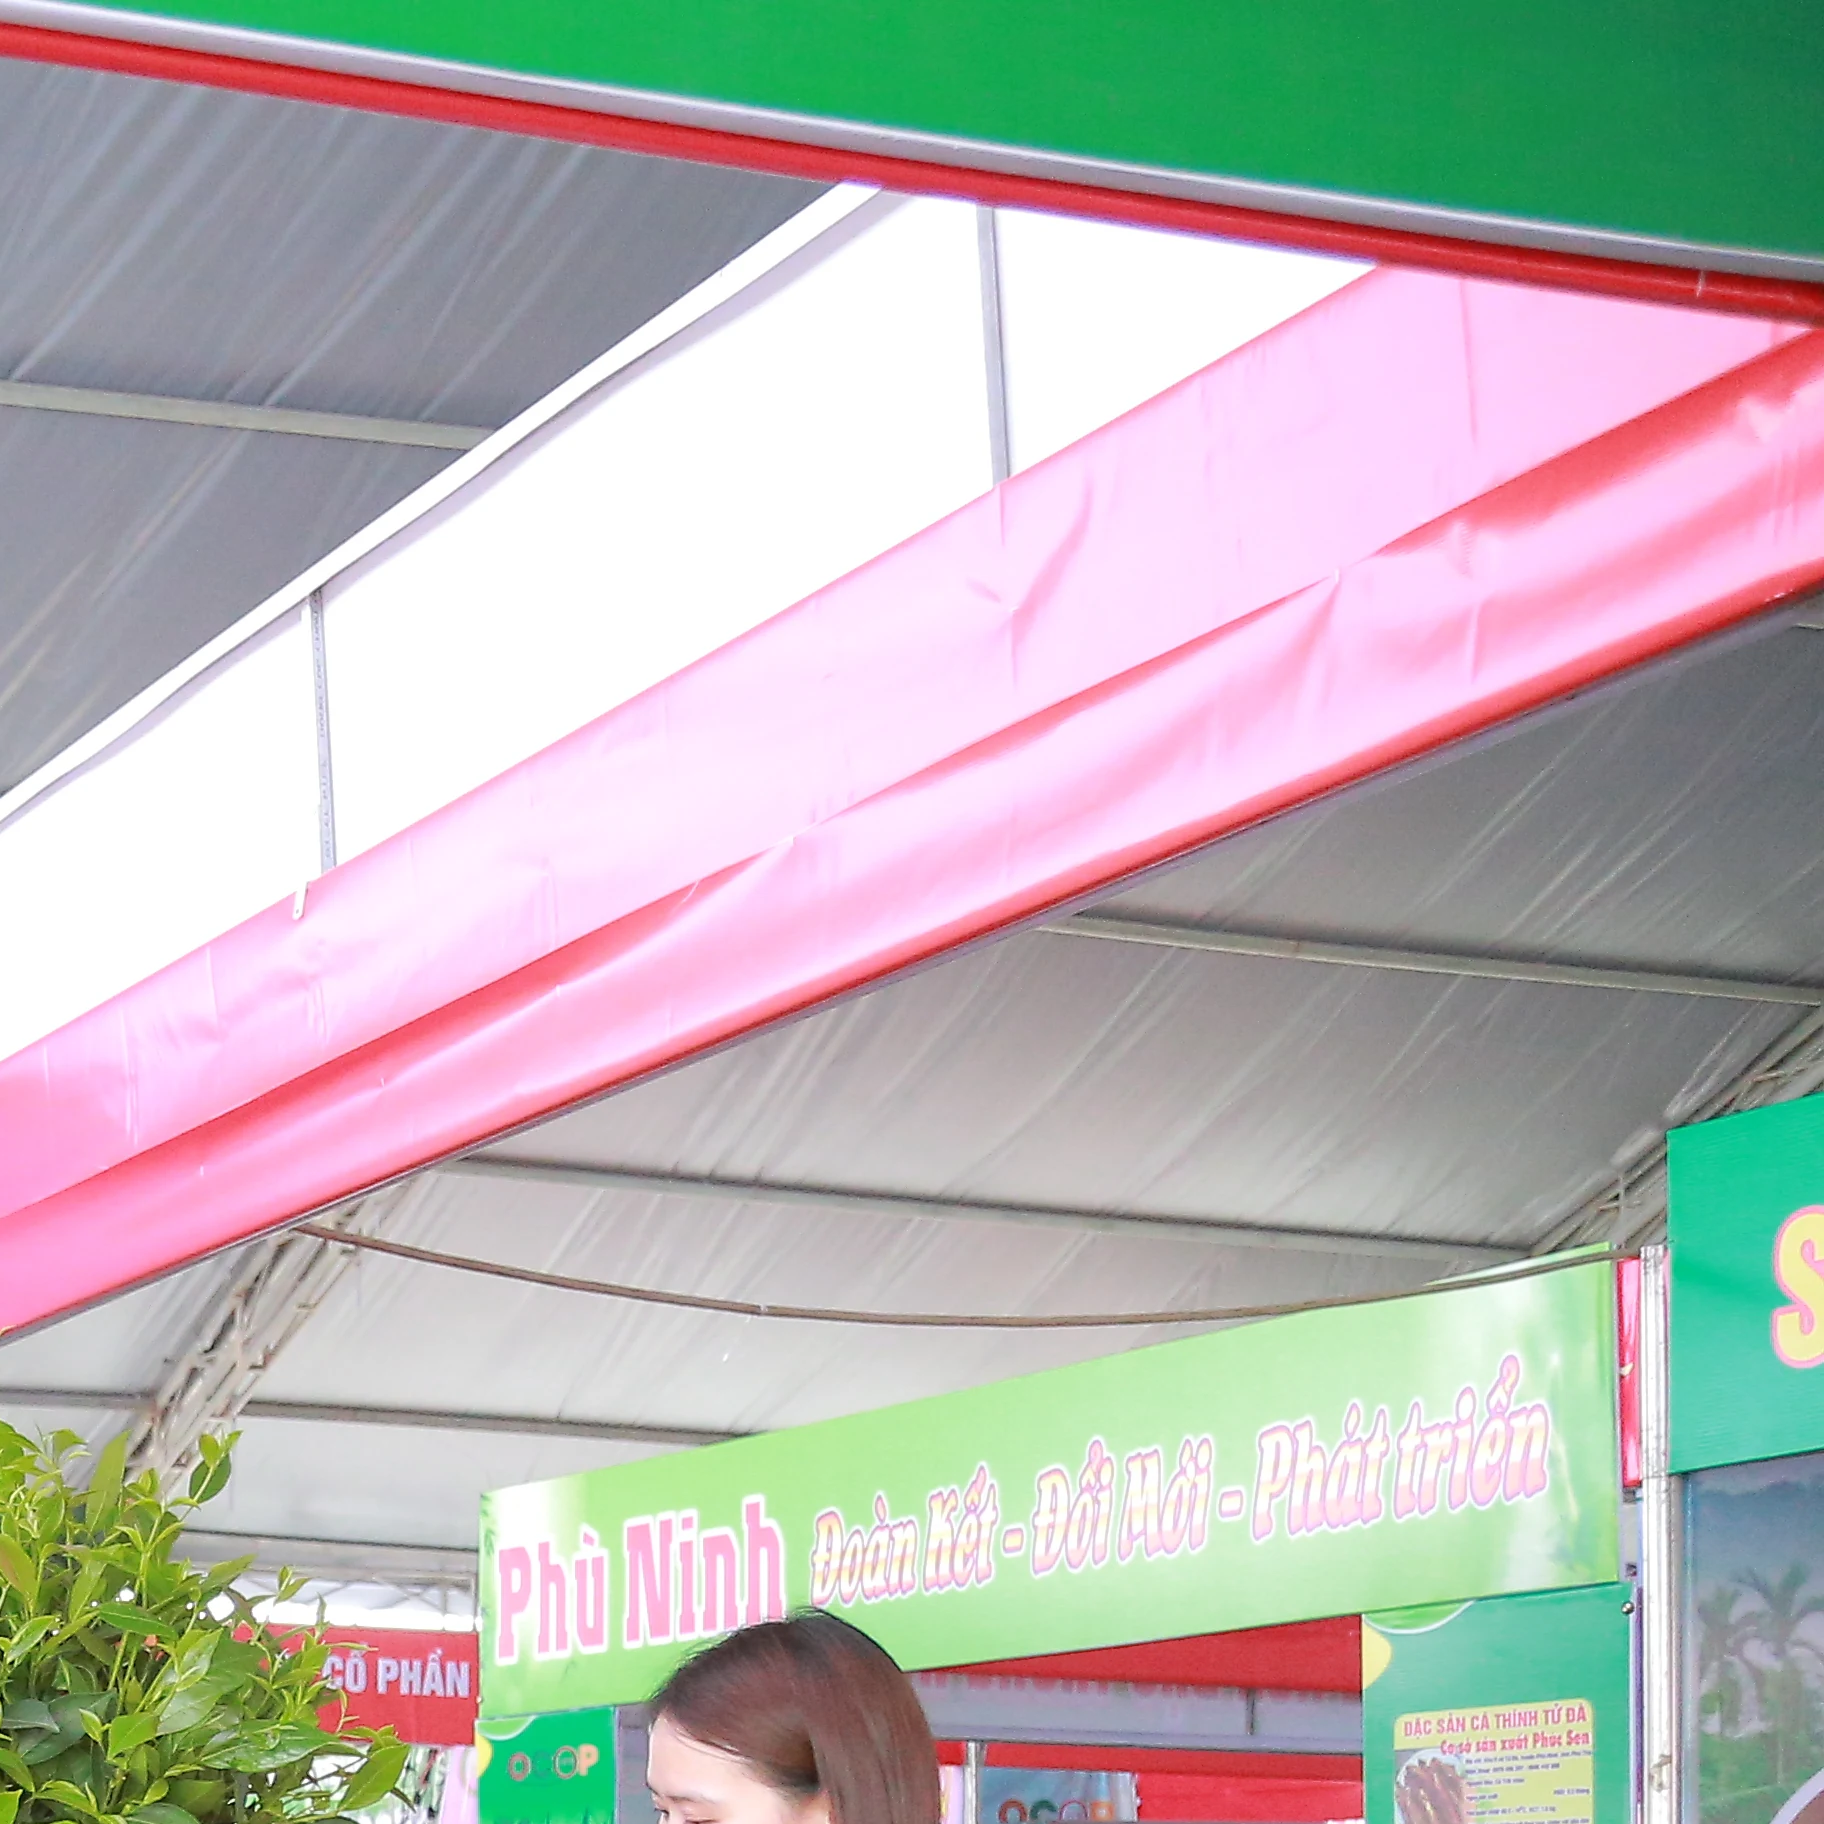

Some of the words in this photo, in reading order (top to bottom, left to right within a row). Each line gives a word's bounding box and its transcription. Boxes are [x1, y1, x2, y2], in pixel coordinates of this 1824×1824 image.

[498, 1531, 608, 1659] Phù
[626, 1499, 787, 1645] Ninh
[813, 1492, 917, 1608] Đoàn
[926, 1464, 997, 1595] Kết
[1032, 1441, 1113, 1577] Đổi
[1120, 1439, 1212, 1561] Mới
[1253, 1406, 1387, 1539] Phát
[1394, 1356, 1549, 1518] triển
